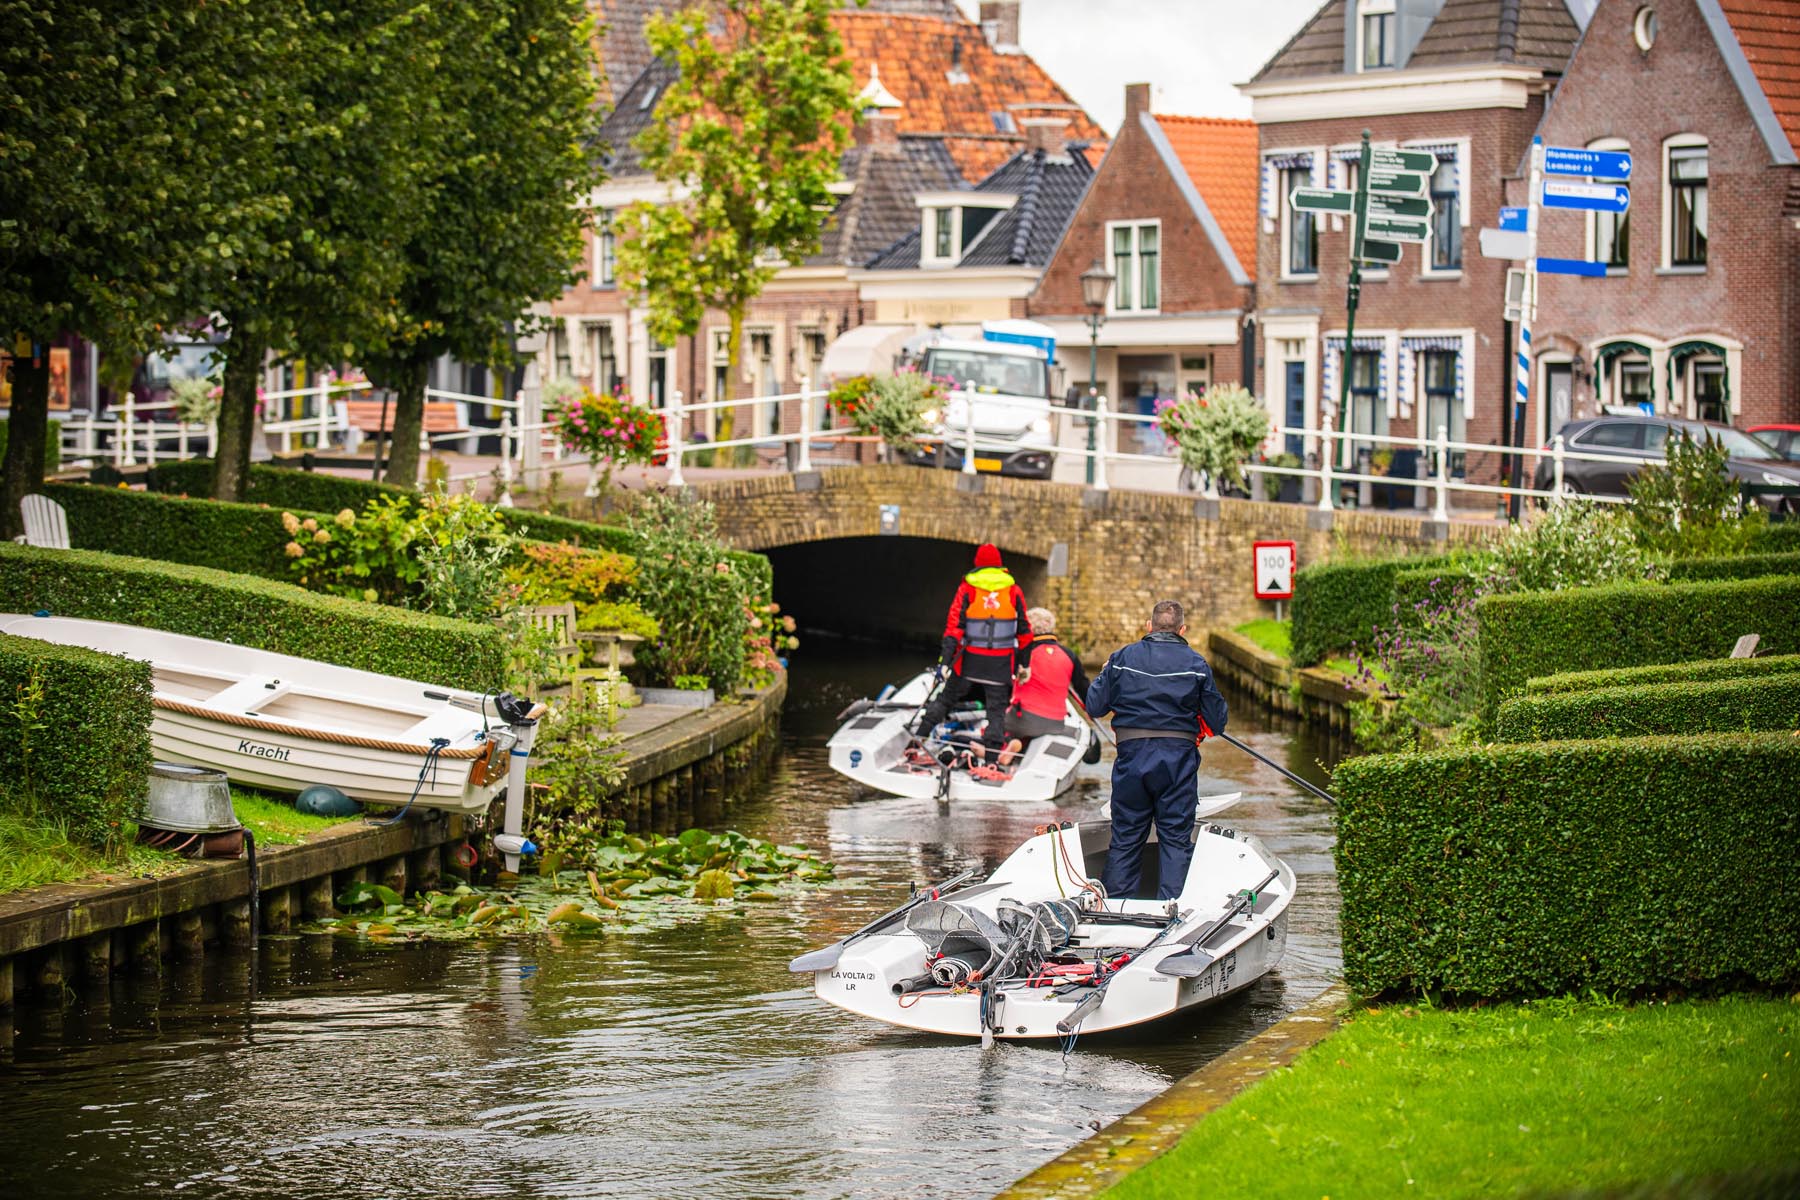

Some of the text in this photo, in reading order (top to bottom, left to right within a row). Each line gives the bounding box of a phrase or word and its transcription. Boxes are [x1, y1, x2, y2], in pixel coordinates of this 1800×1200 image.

[1264, 555, 1285, 569] 100
[238, 739, 291, 761] Kracht
[831, 971, 841, 979] LA
[842, 971, 866, 980] VOLTA
[846, 983, 856, 991] LR
